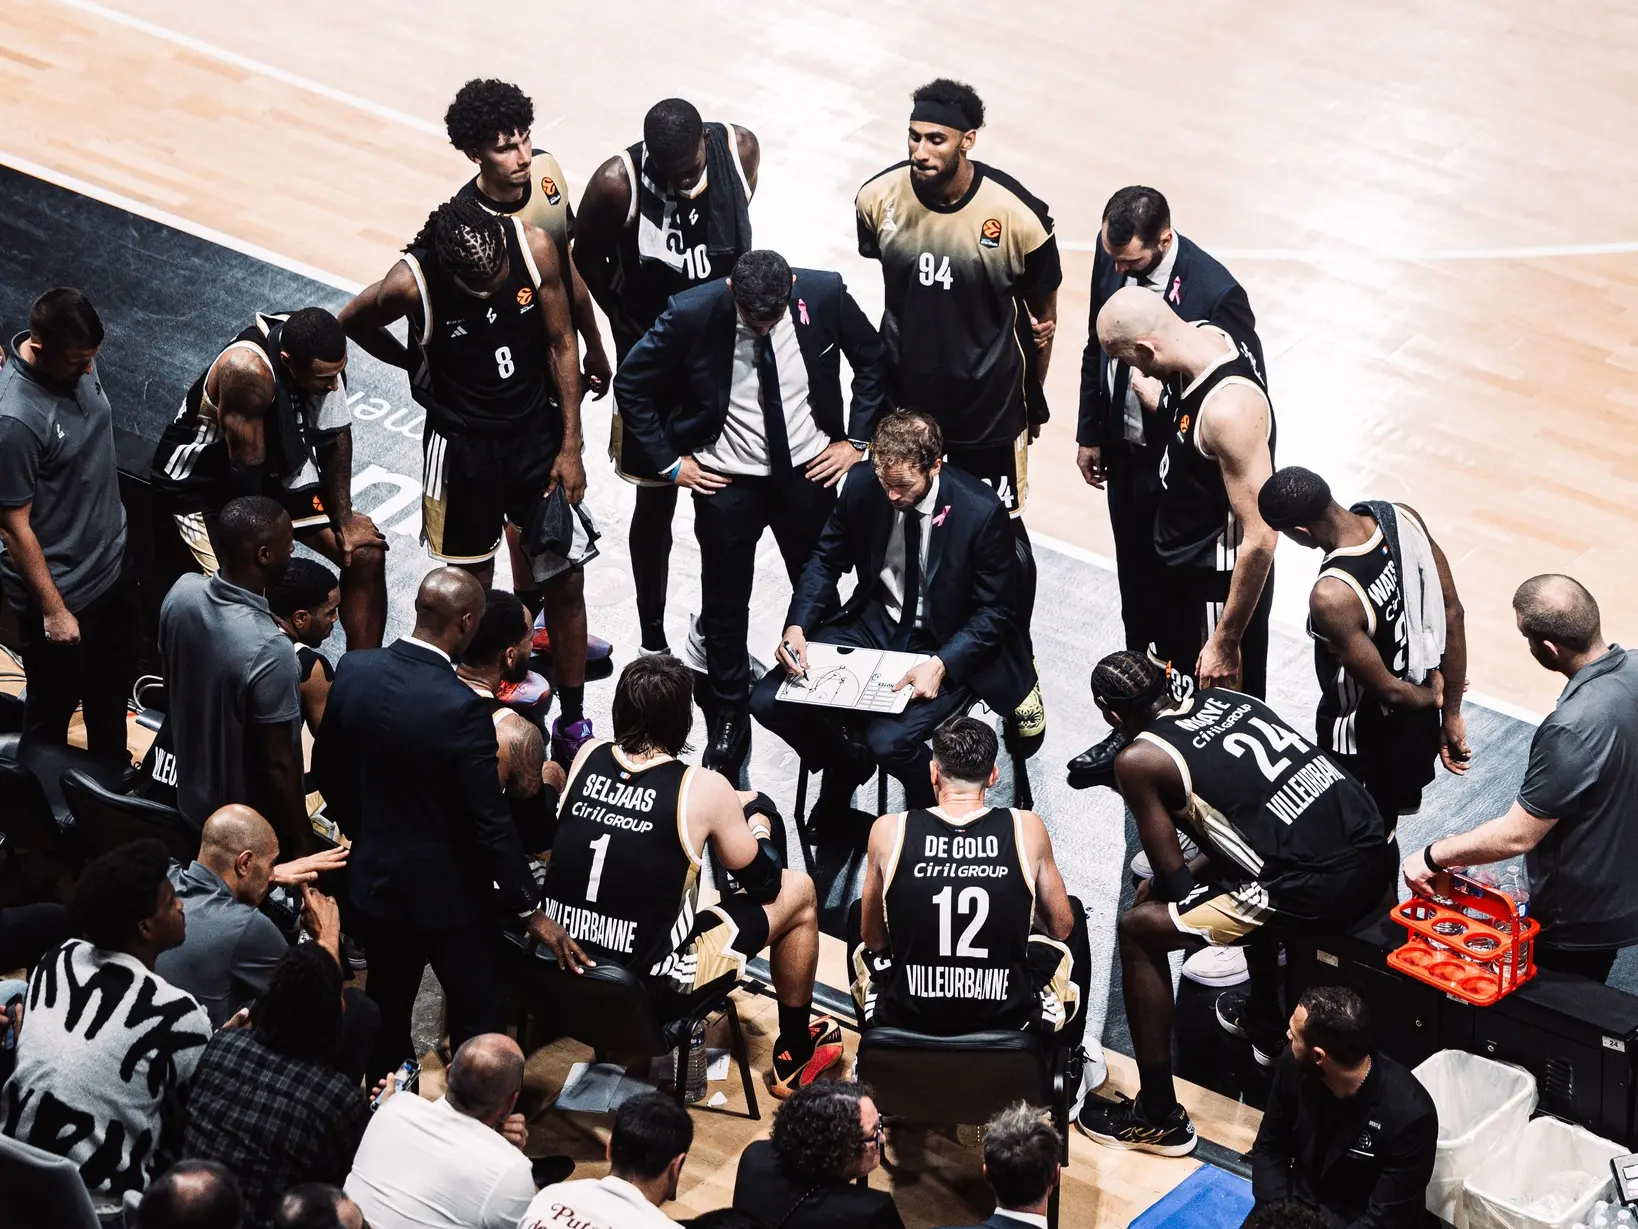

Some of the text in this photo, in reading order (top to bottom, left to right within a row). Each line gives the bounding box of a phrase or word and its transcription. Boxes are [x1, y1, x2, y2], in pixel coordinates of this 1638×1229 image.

[683, 244, 711, 280] 10
[918, 252, 953, 290] 94
[495, 346, 515, 379] 8
[1223, 716, 1311, 783] 24
[582, 773, 657, 812] SELJAAS
[571, 801, 653, 833] CirilGROUP
[924, 835, 999, 859] DE COLO
[585, 833, 611, 903] 1
[913, 862, 1009, 878] CirilGROUP
[932, 886, 990, 959] 12
[906, 964, 1010, 1001] VILLEURBANNE
